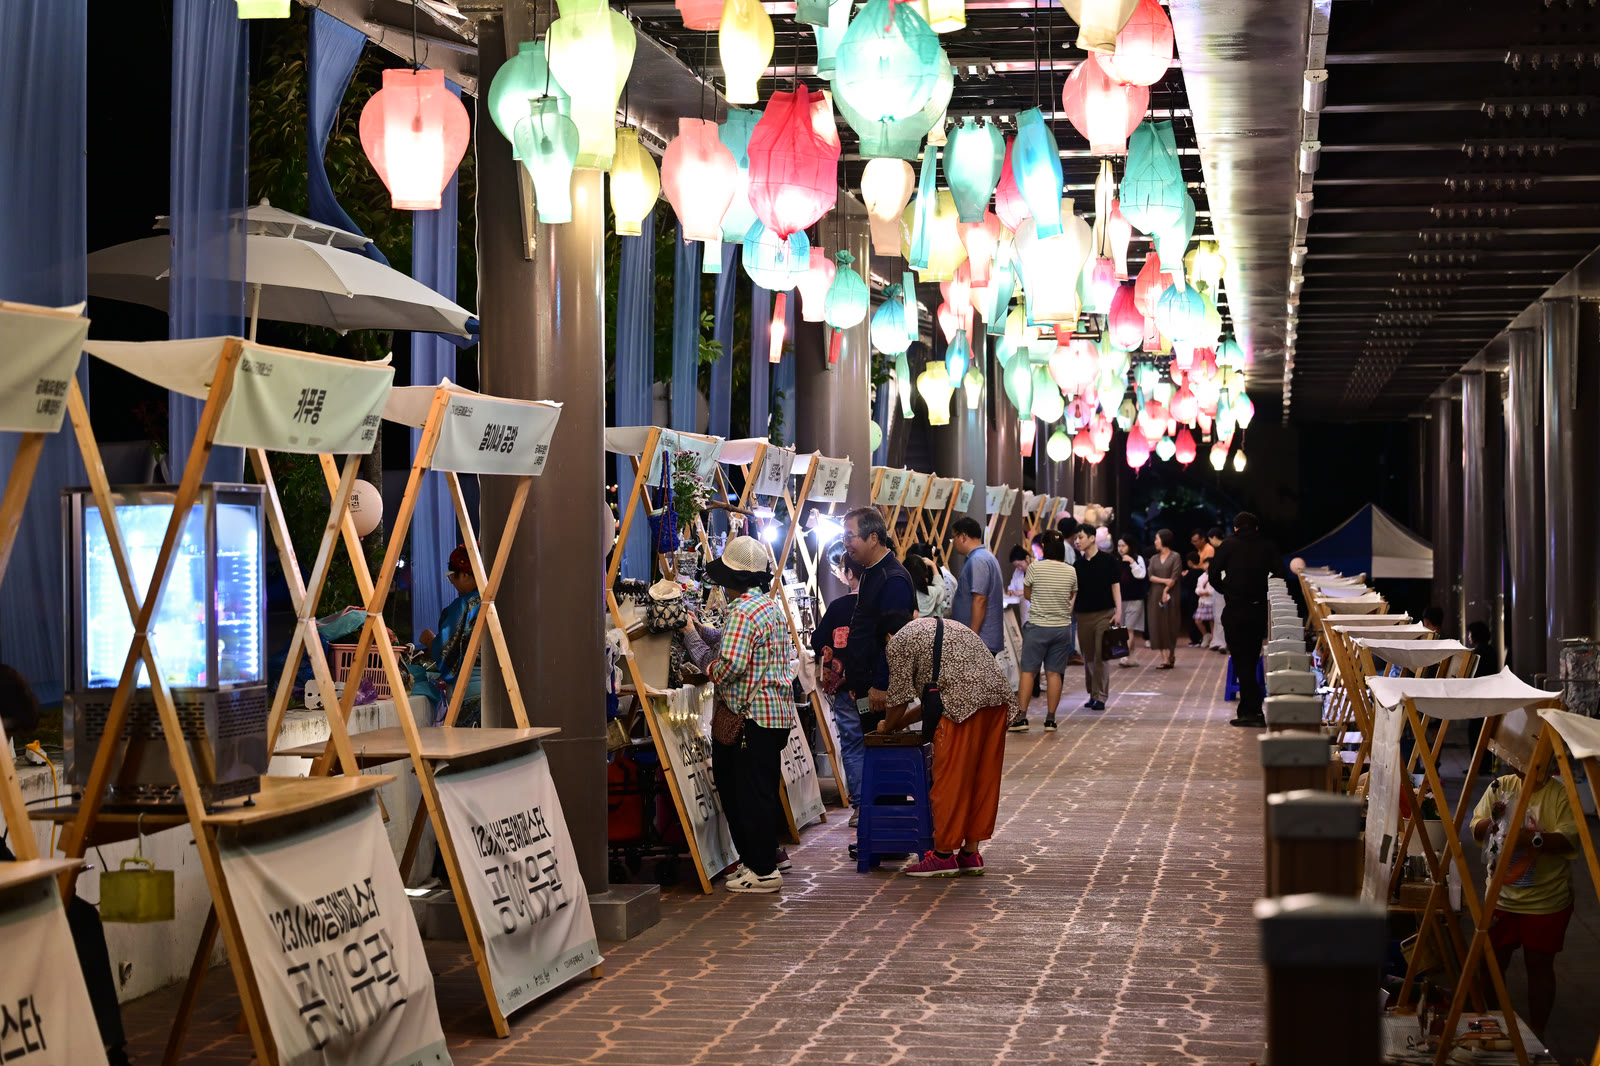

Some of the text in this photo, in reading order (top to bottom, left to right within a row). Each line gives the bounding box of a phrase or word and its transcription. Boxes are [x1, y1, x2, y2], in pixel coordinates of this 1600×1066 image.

[292, 387, 327, 425] 카푸롱
[470, 805, 552, 858] 123사비공예페스타
[268, 876, 381, 954] 123사비공예페스타
[484, 846, 570, 935] 공예유람
